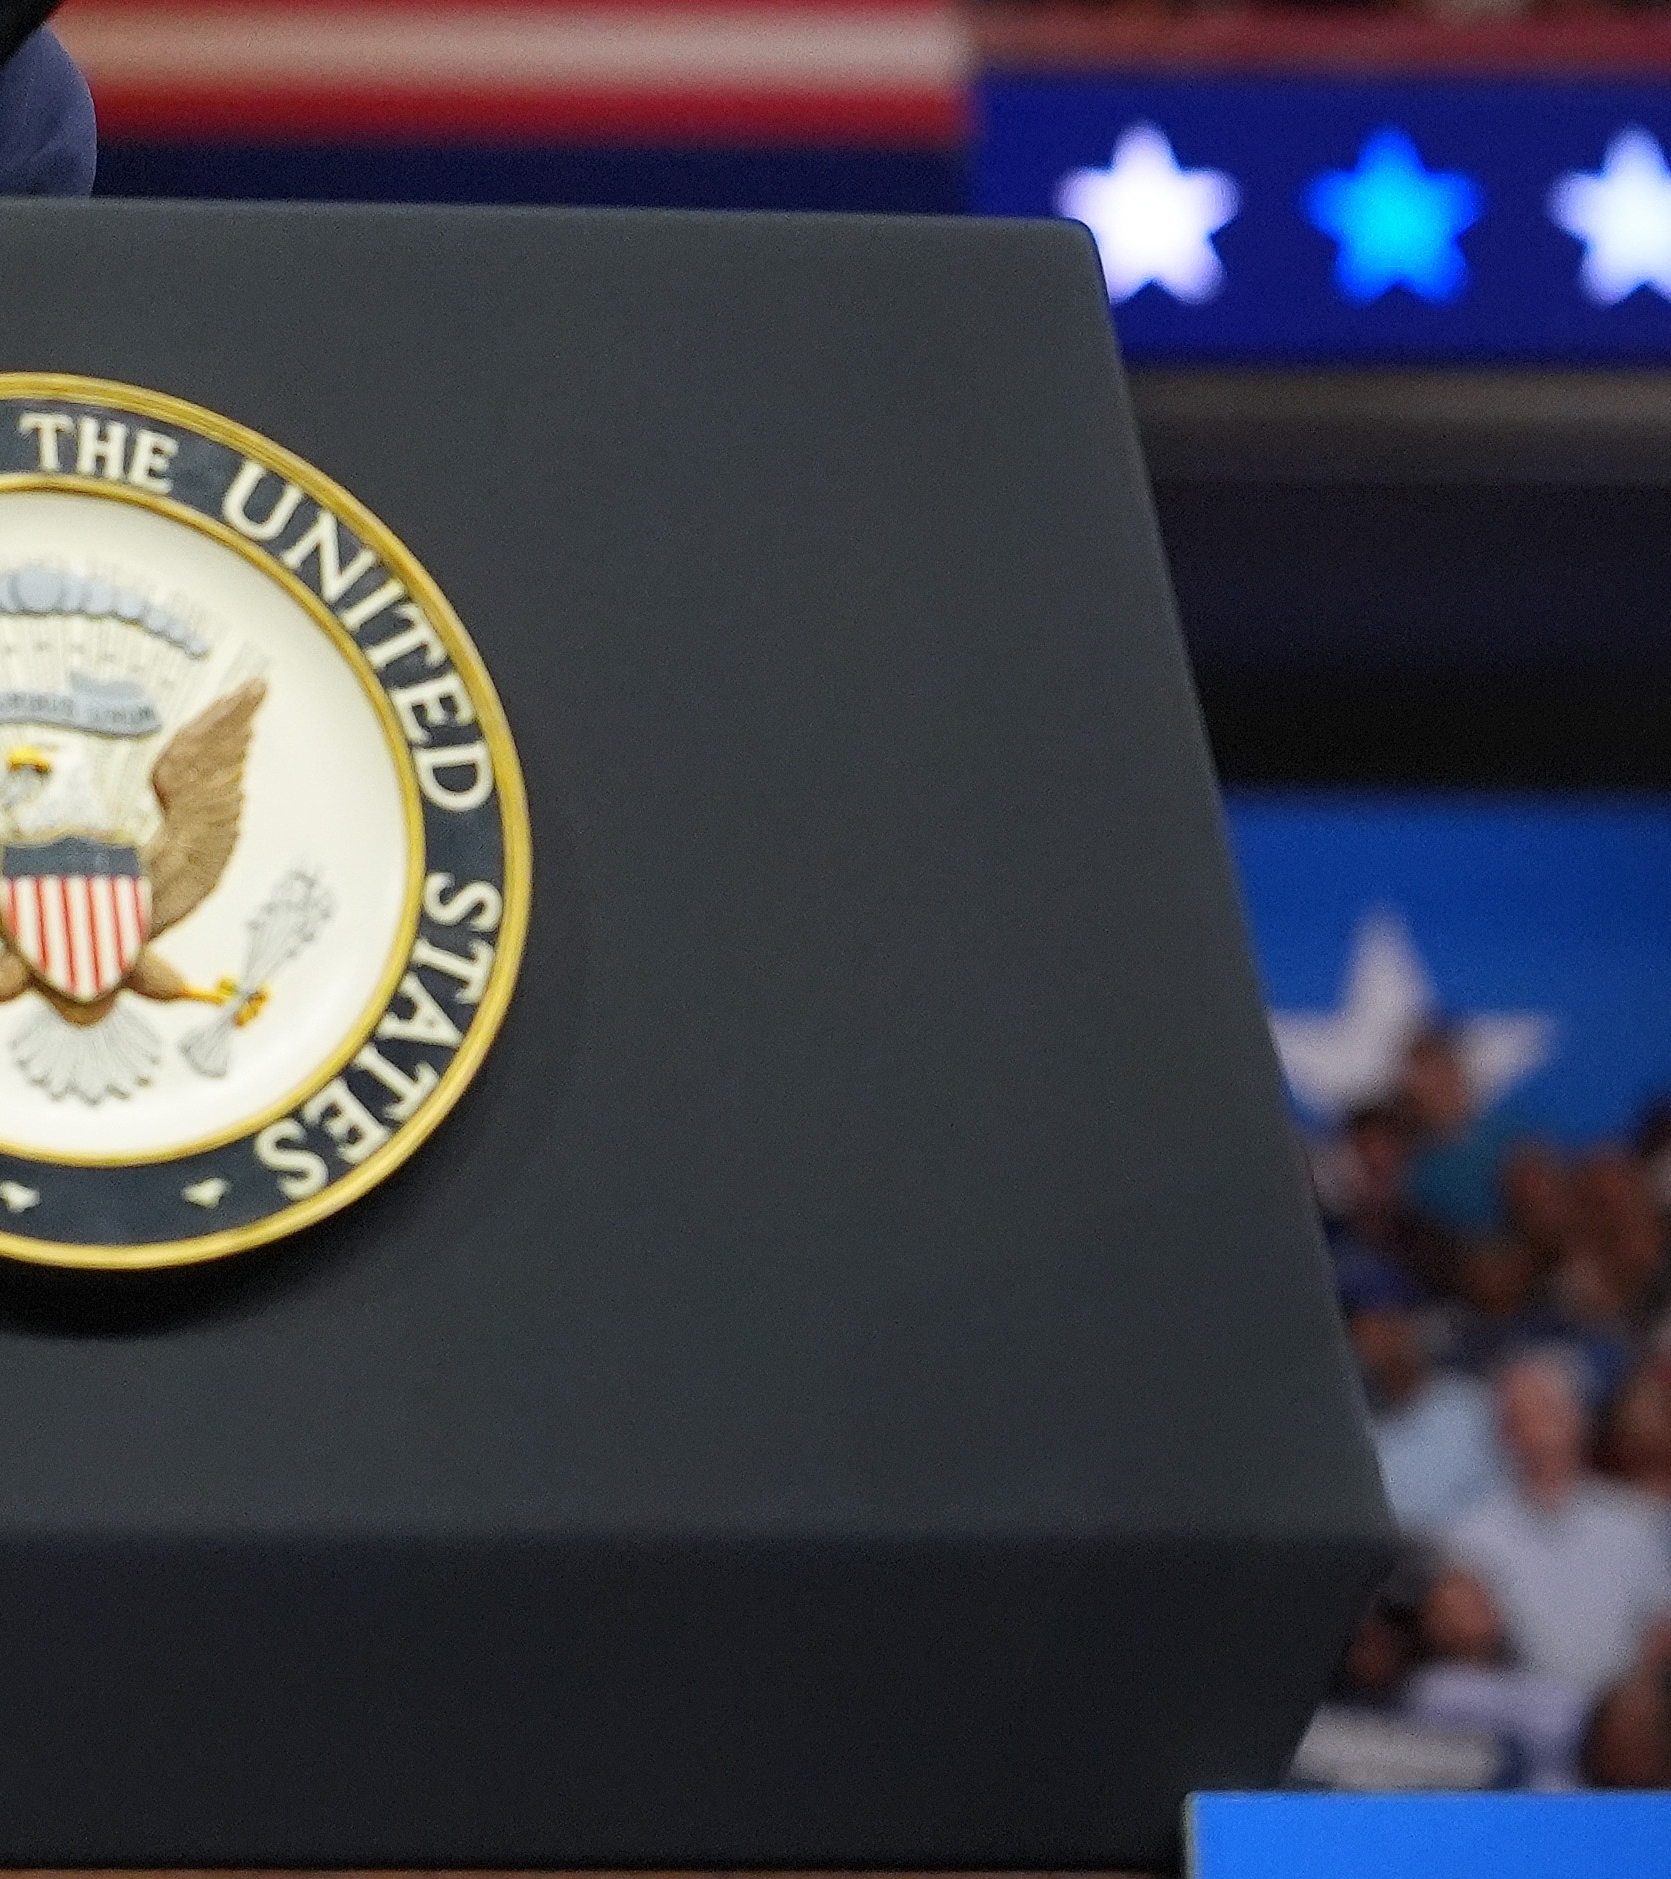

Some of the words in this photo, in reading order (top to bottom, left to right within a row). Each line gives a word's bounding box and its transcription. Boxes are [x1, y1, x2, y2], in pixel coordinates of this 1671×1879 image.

[18, 411, 179, 495] THE
[220, 463, 496, 812] UNITED
[254, 870, 502, 1201] STATES
